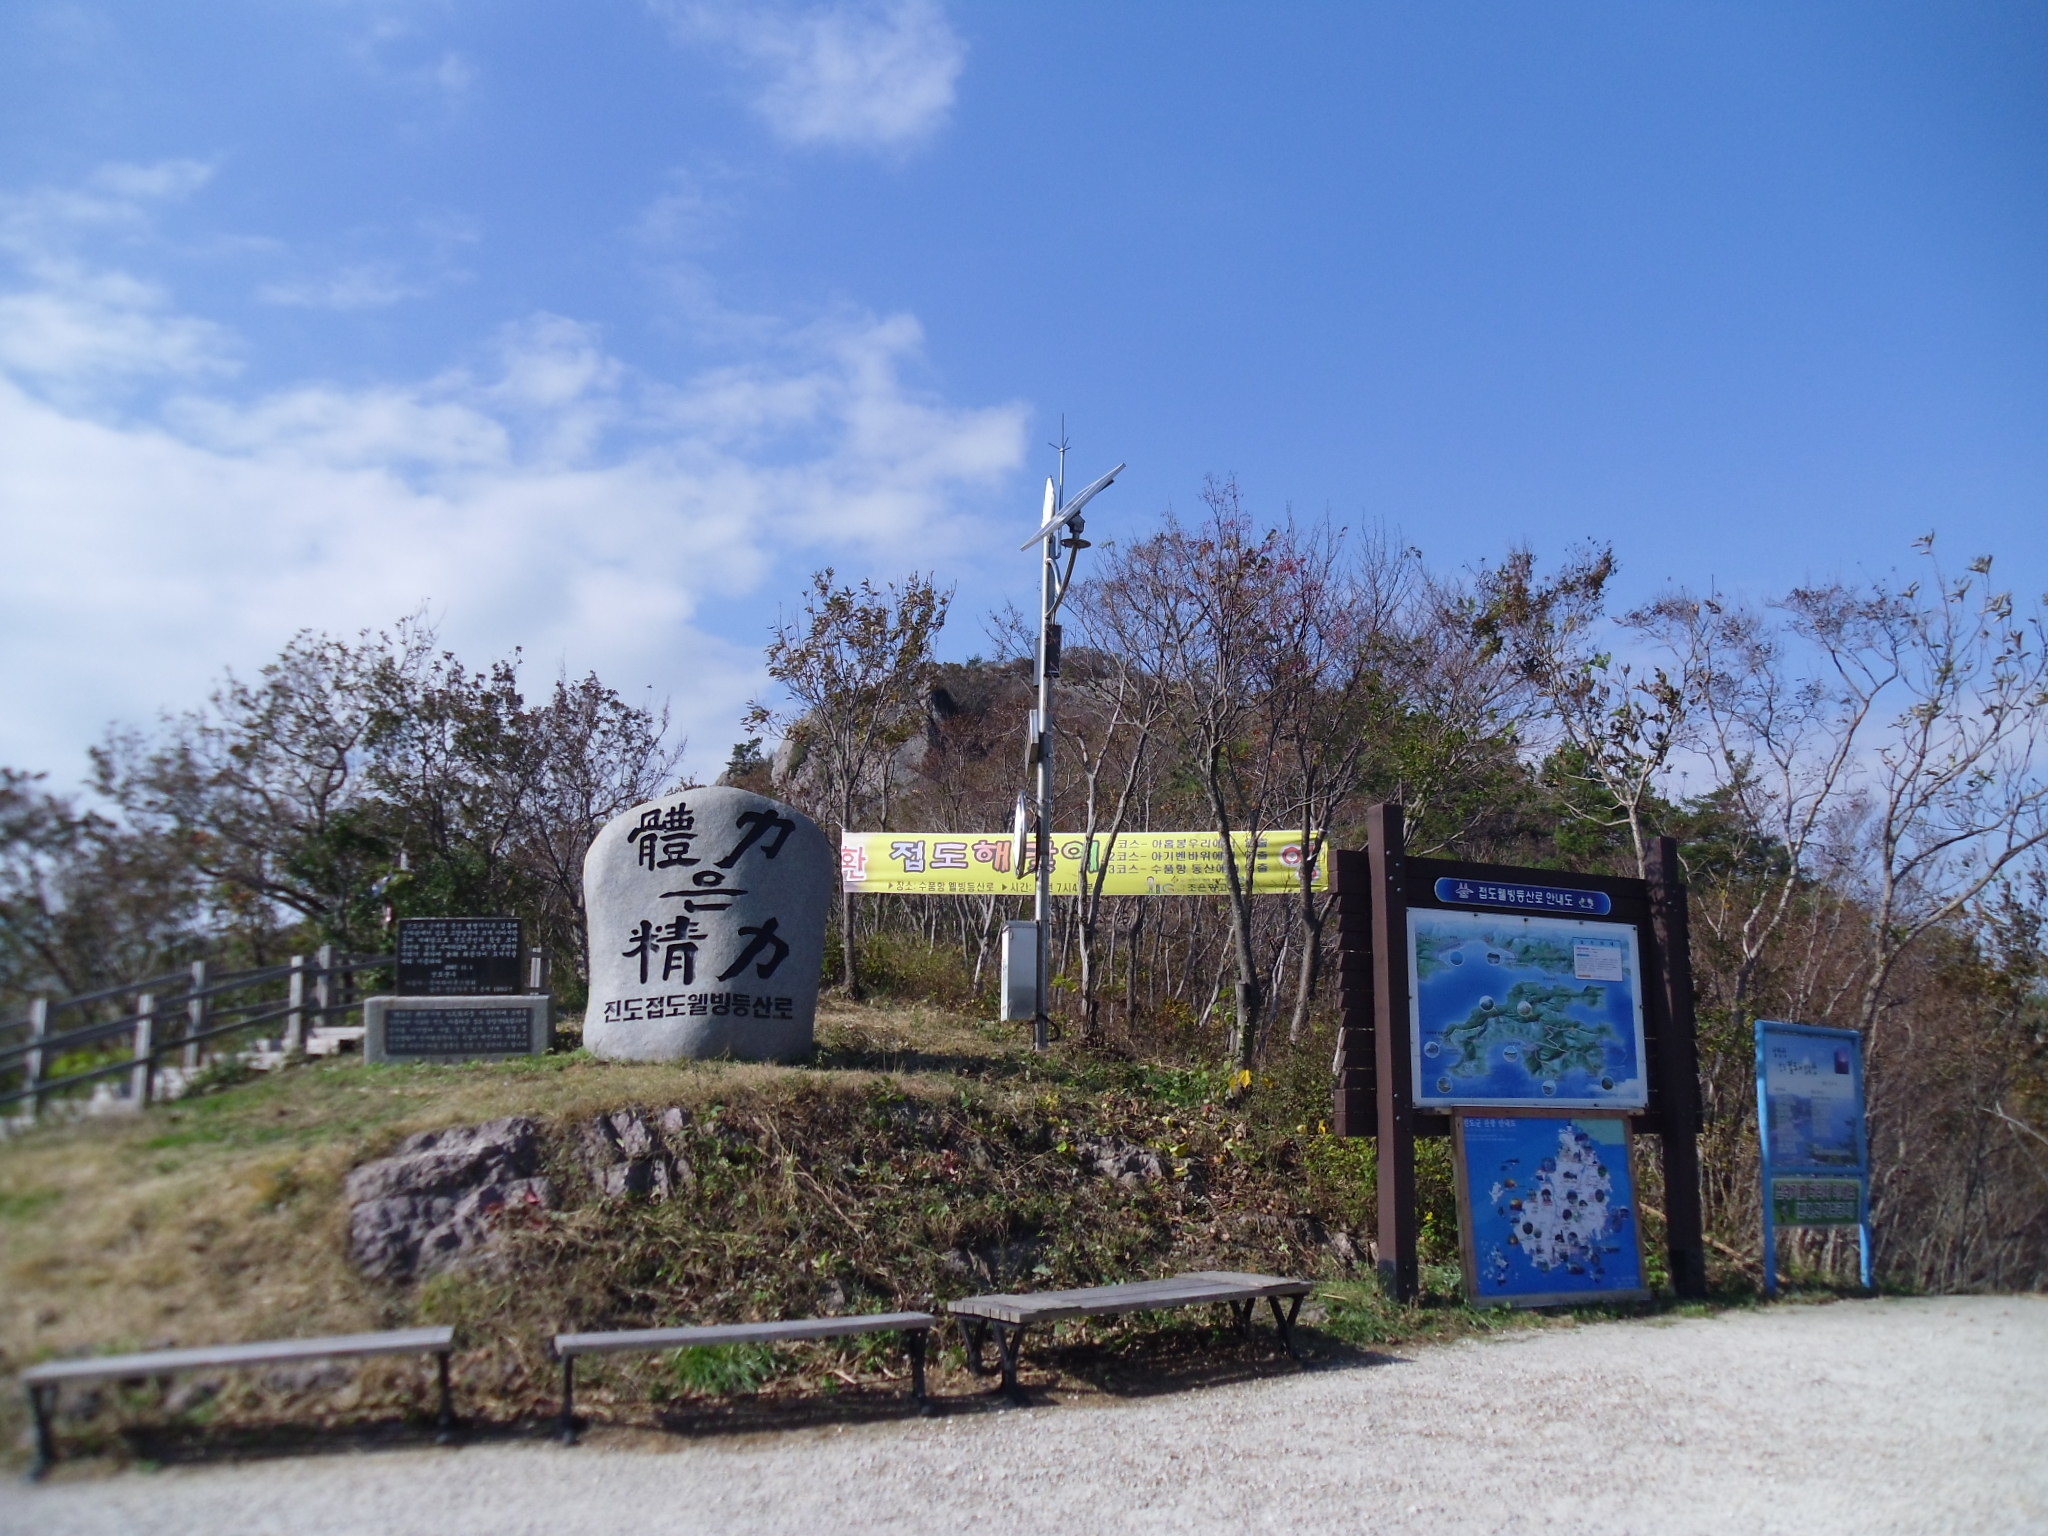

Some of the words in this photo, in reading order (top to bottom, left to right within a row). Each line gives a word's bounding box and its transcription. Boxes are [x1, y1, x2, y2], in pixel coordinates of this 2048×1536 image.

[1479, 886, 1544, 904] 접도웰빙등산로
[1545, 892, 1574, 906] 안내도
[603, 992, 793, 1023] 진도접도웰빙등산로
